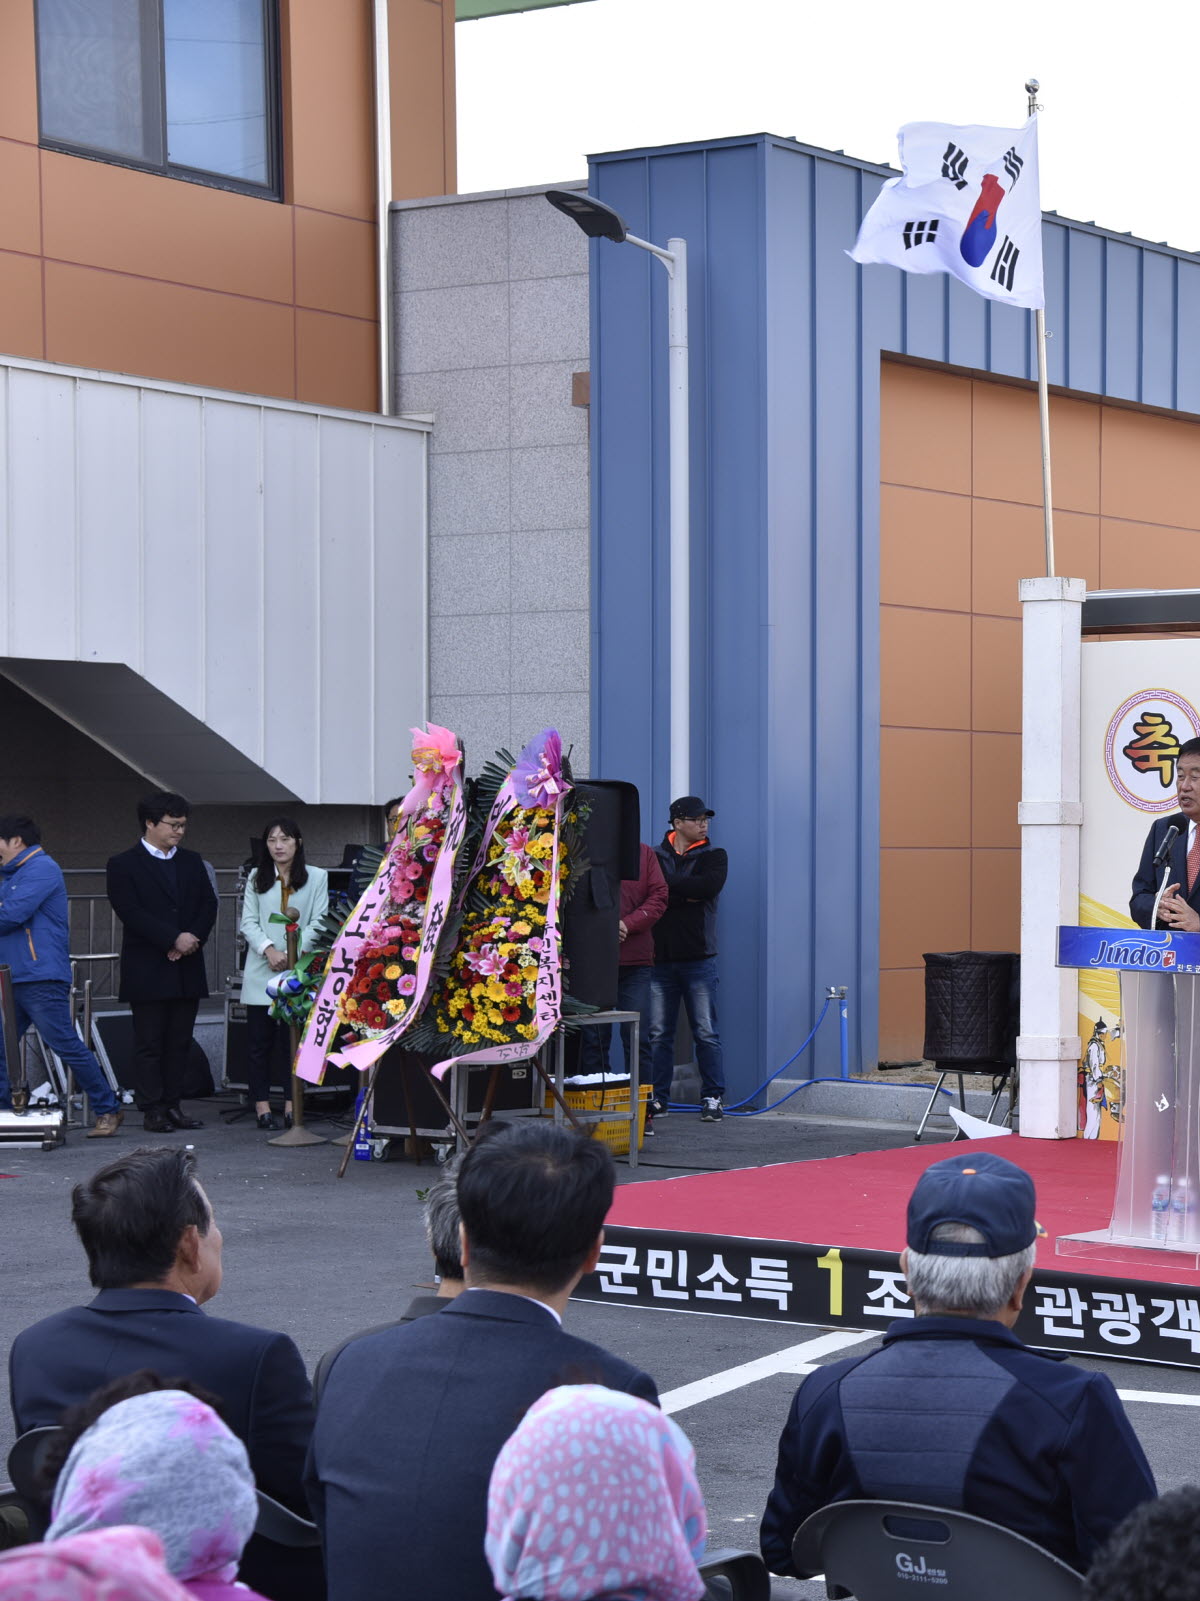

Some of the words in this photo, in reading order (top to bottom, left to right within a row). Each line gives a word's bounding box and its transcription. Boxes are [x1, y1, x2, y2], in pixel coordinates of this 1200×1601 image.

[1122, 711, 1180, 789] 축
[1089, 940, 1162, 968] Jindo
[595, 1245, 793, 1312] 군민소득
[895, 1552, 927, 1575] GJ
